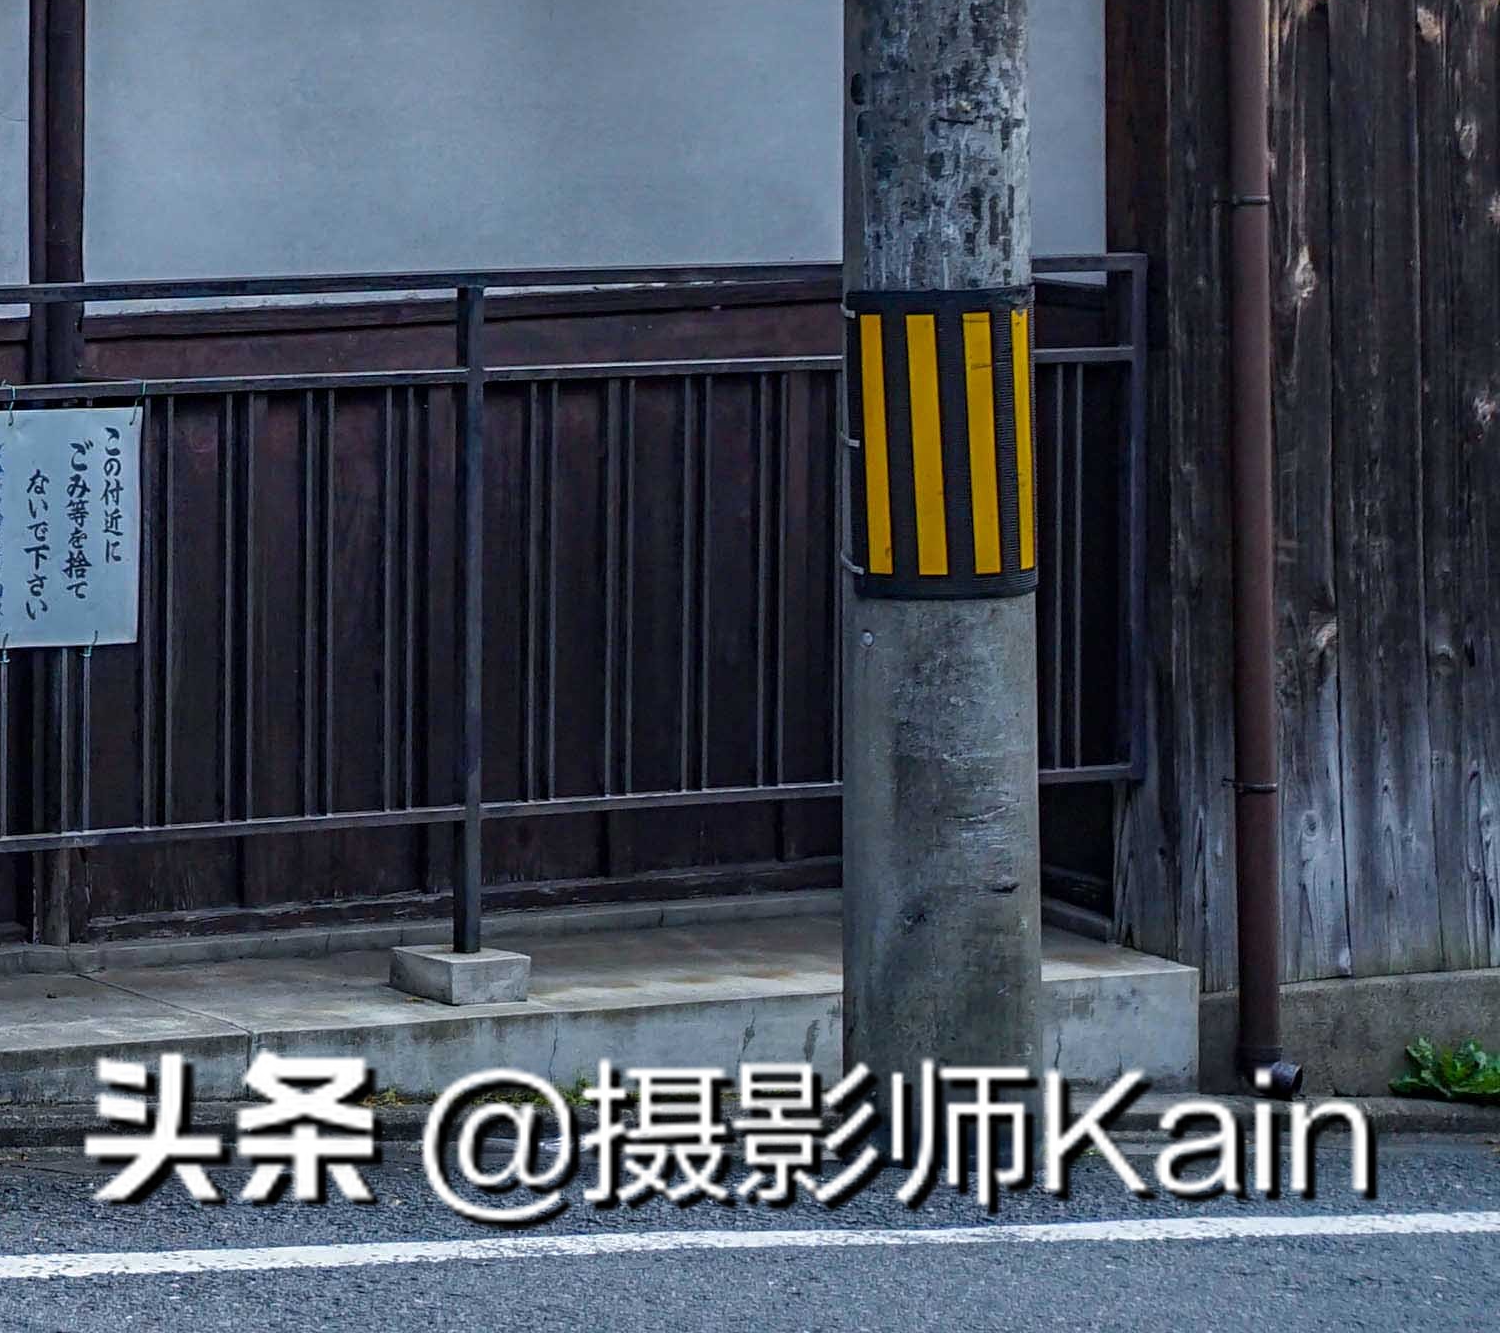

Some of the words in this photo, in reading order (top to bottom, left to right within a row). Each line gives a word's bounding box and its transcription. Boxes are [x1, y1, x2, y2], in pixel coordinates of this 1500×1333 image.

[23, 468, 51, 621] ないで下さい
[62, 439, 94, 600] ごみ等を捨て
[100, 427, 124, 563] この付近に
